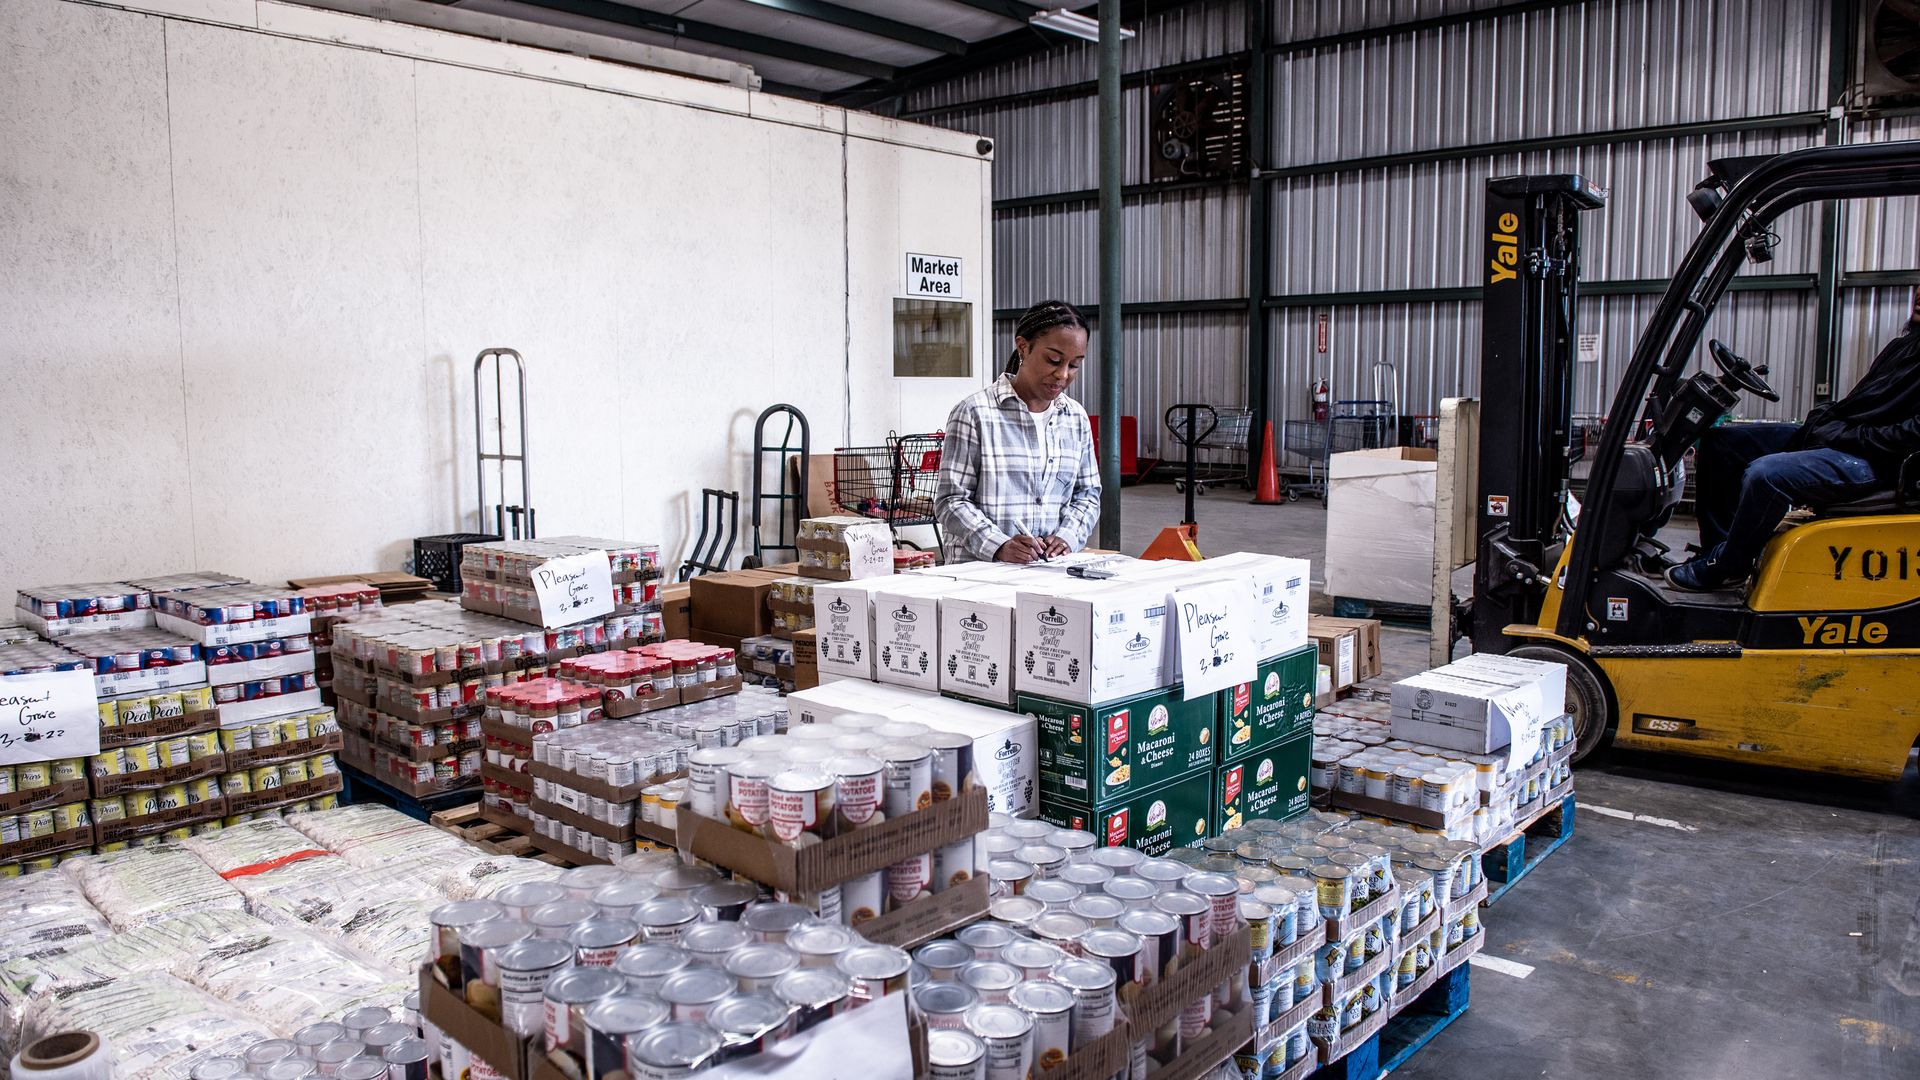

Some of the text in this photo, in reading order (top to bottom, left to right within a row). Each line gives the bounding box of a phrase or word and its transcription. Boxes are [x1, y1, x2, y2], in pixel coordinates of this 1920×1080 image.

[1491, 212, 1519, 284] Yale
[911, 257, 959, 276] Market
[920, 276, 951, 293] Area
[1828, 546, 1920, 581] Y01
[538, 568, 586, 589] Pleasant
[568, 581, 589, 597] Grove
[1184, 603, 1227, 633] Pleasant
[1211, 625, 1230, 648] Grove
[1797, 616, 1889, 644] Yale
[152, 704, 181, 719] Pears
[1256, 697, 1285, 716] Macaroni
[19, 706, 57, 726] Grove
[123, 710, 151, 725] Pear
[1039, 714, 1065, 725] Macaroni
[1300, 710, 1312, 721] BOXES
[1648, 719, 1679, 732] CSS
[101, 731, 148, 744] REGON TRAIL
[1110, 729, 1127, 738] Macaroni
[1137, 732, 1176, 754] Macaroni
[1188, 746, 1211, 762] 24 BOXES
[22, 773, 41, 782] Pears
[860, 778, 876, 786] white
[104, 783, 133, 795] OREGON
[738, 786, 769, 796] POTATO
[839, 786, 876, 797] POTATOES
[1247, 782, 1278, 802] Macaroni
[160, 800, 178, 810] ears
[233, 799, 260, 811] OREGON
[771, 801, 803, 812] POTATOES
[1288, 792, 1307, 807] 24 BOXES
[1039, 814, 1066, 827] Macaroni
[1109, 828, 1126, 838] Macaroni
[1136, 826, 1172, 850] Macaroni
[1144, 841, 1171, 858] Cheese
[597, 951, 617, 959] white
[502, 973, 550, 981] Nutrition Facts
[931, 1067, 975, 1077] Nutrition Facts
